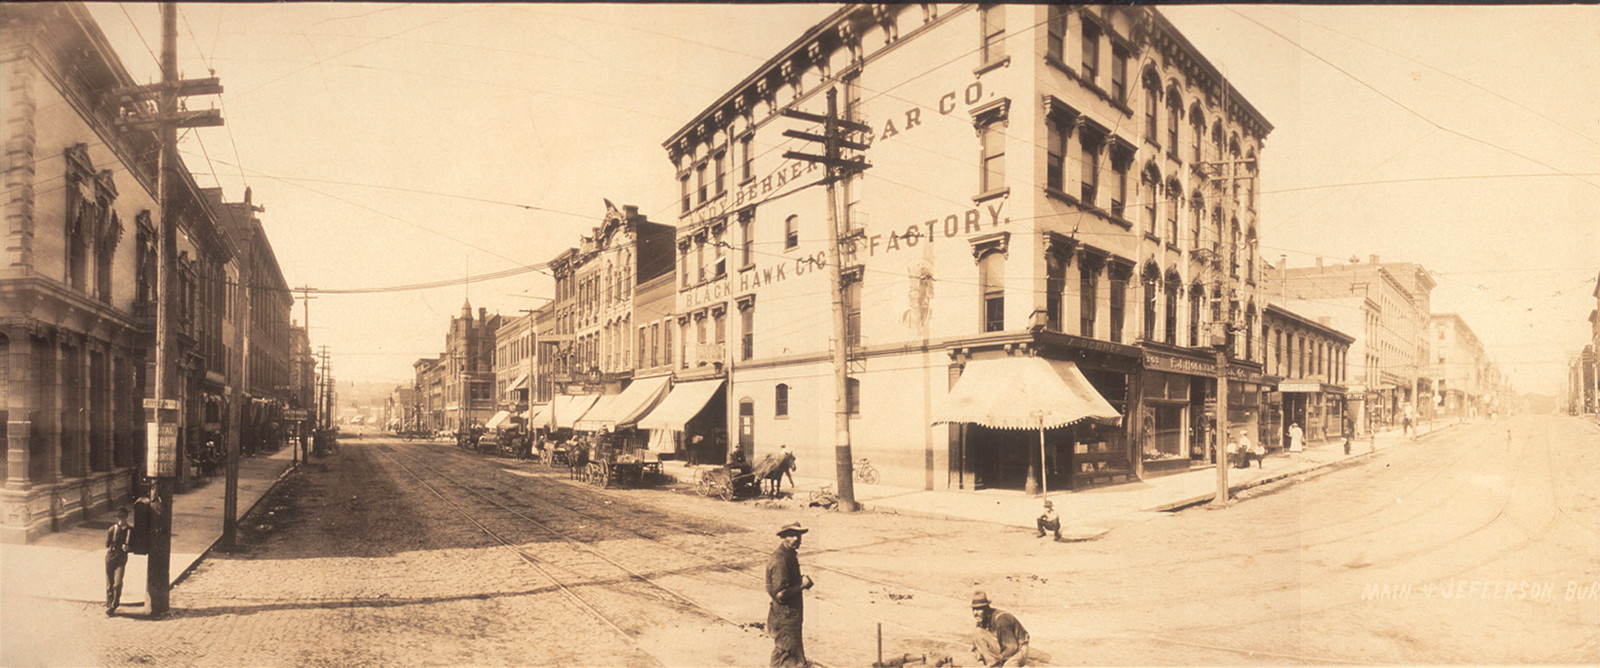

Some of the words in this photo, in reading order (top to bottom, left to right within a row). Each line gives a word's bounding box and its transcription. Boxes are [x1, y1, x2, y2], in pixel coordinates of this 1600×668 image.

[938, 81, 995, 115] CO.
[686, 282, 731, 307] BLACK
[740, 262, 786, 292] HAWK
[795, 241, 858, 276] CIGR
[870, 201, 1011, 257] FACTORY.
